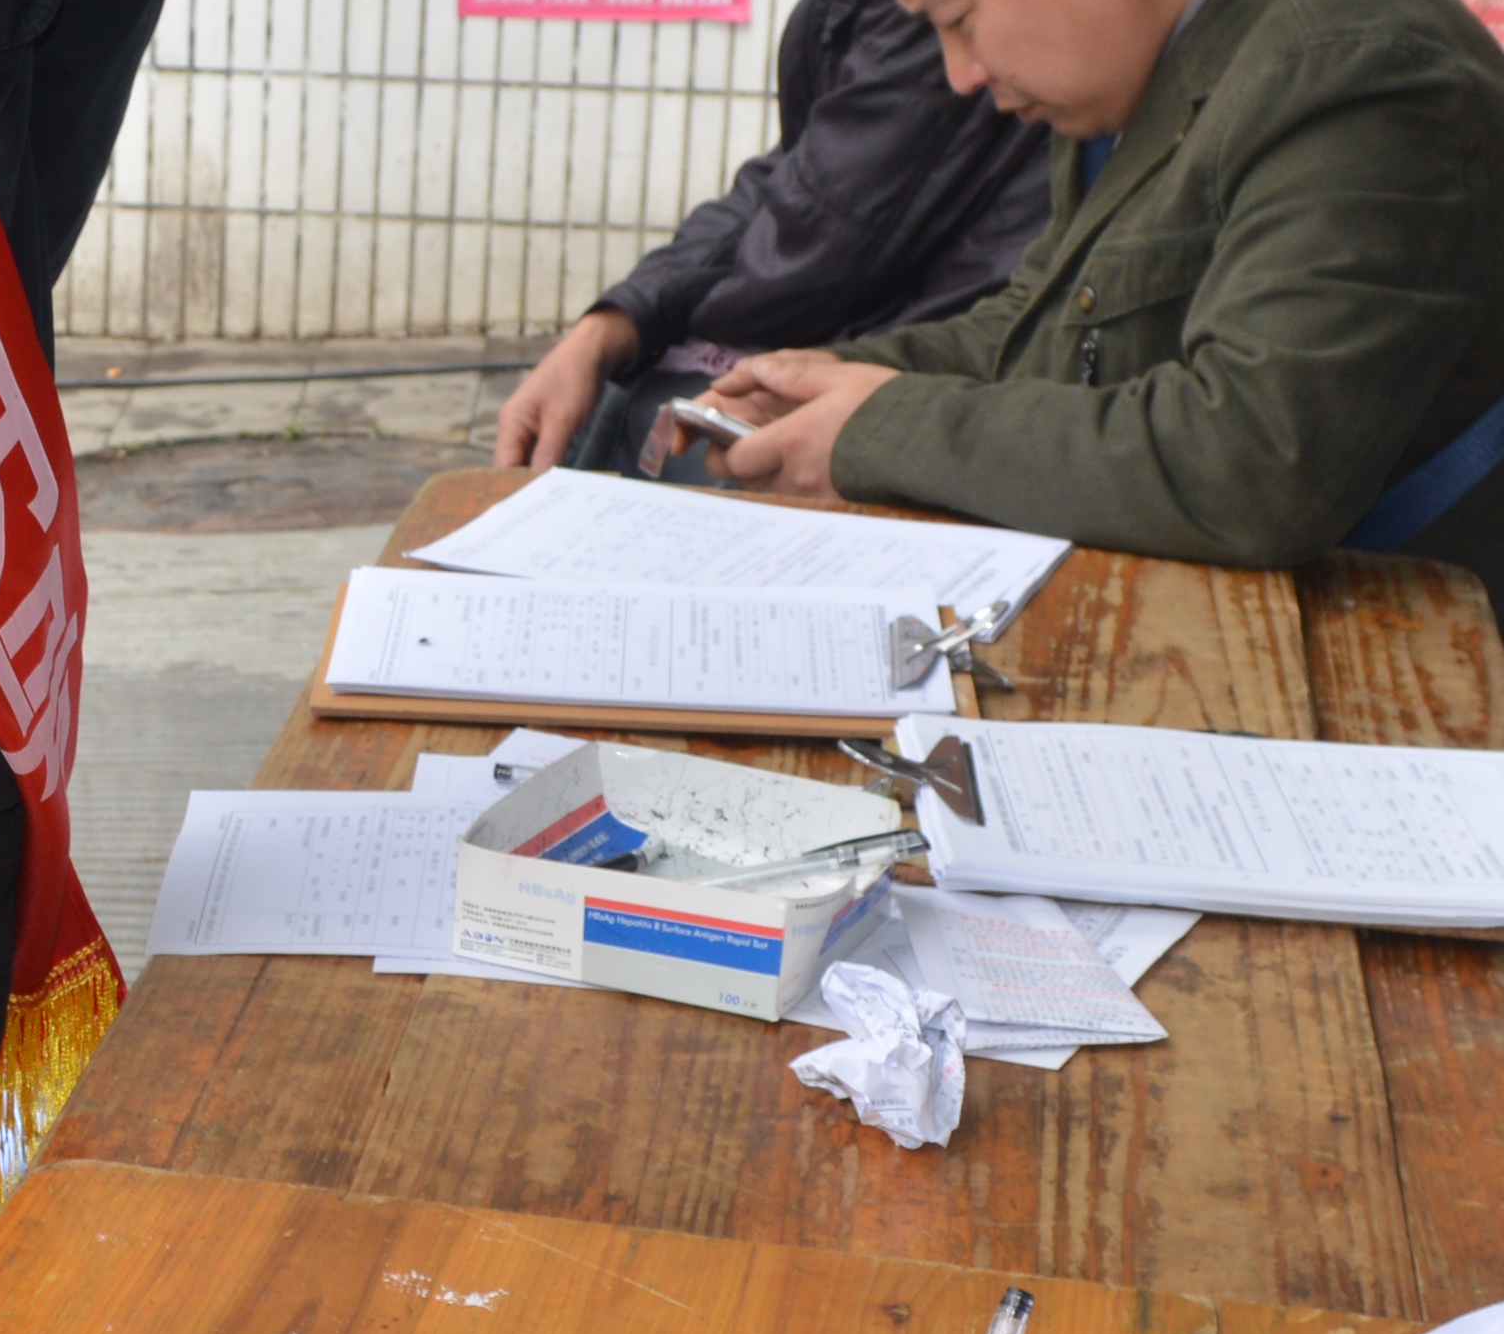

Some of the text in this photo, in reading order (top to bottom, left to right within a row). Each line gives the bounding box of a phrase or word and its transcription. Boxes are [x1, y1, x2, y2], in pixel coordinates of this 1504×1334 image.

[518, 880, 577, 906] HBsAg
[662, 922, 693, 937] Surface
[693, 928, 725, 945] Antigen
[726, 933, 752, 949] Rapid
[752, 938, 769, 951] Test
[718, 992, 741, 1007] 100
